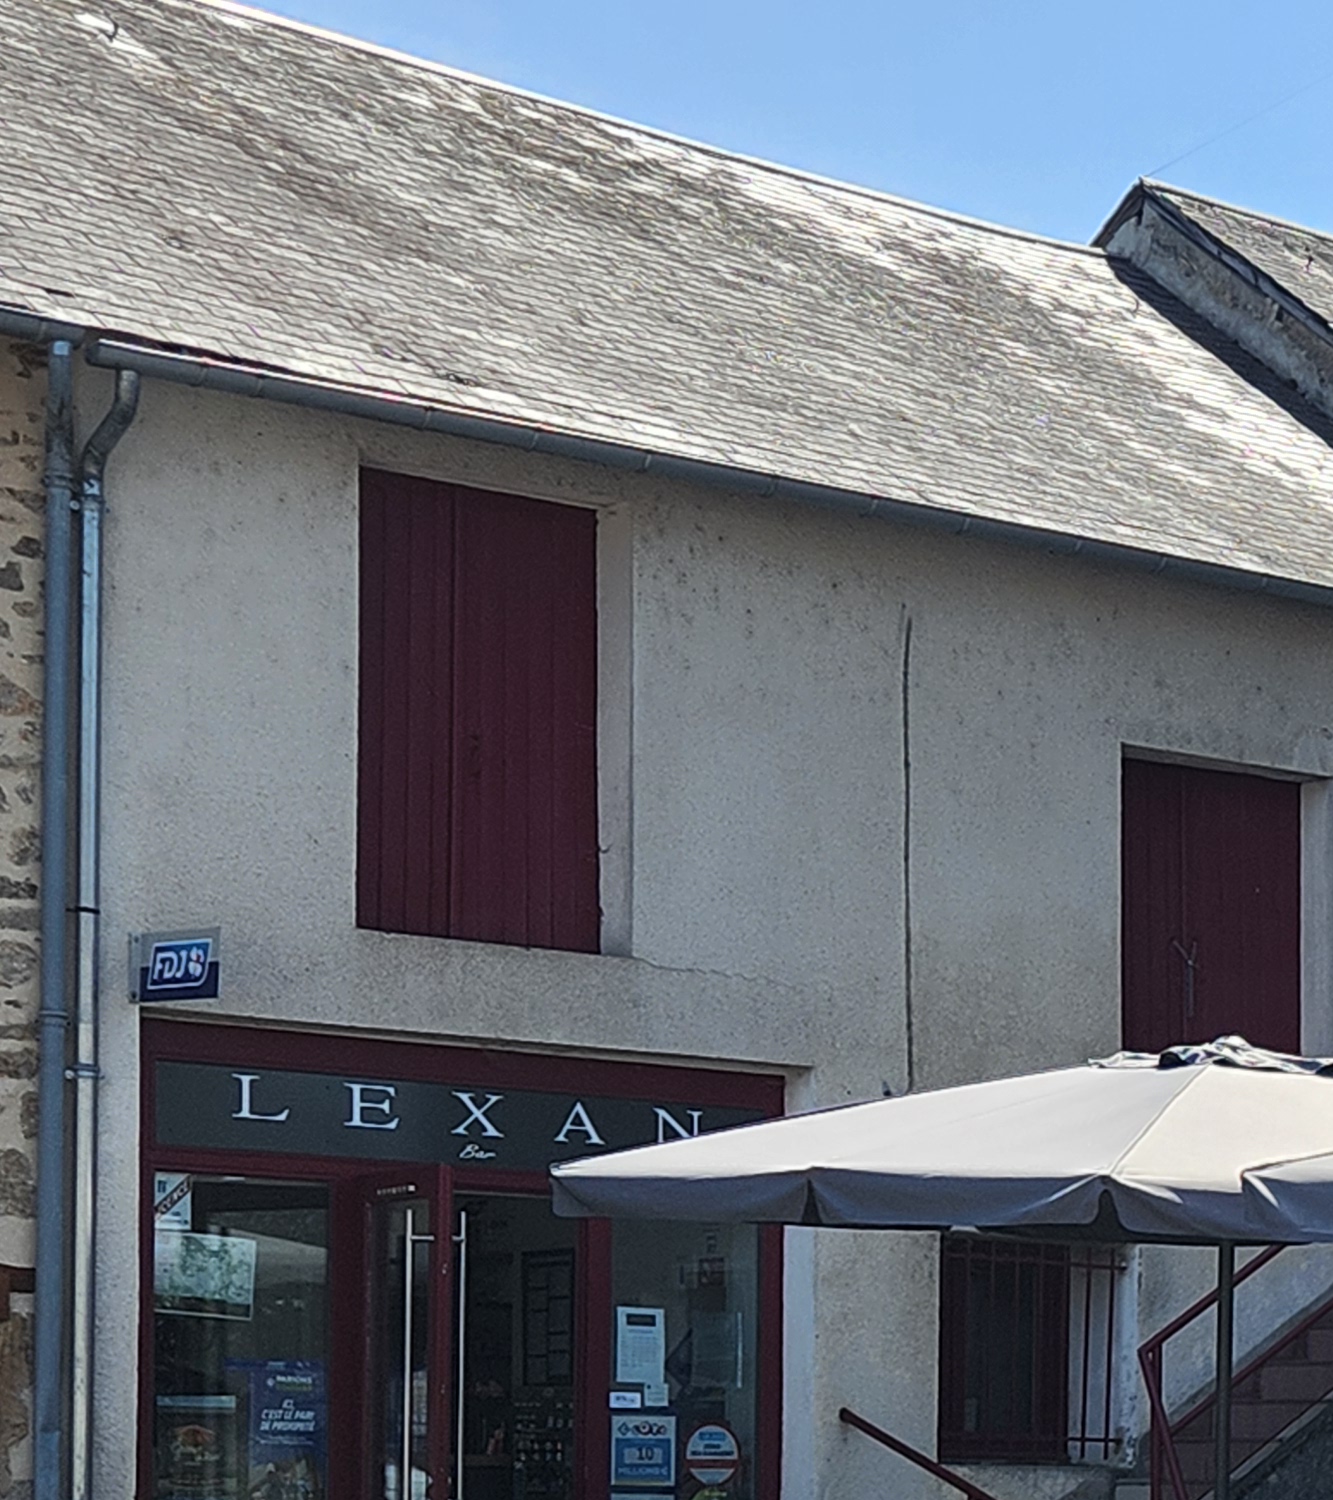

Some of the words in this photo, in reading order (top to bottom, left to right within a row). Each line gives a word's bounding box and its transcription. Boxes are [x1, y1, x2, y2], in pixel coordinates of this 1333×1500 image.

[152, 949, 189, 980] FDJ
[231, 1072, 704, 1146] LEXAN
[458, 1143, 497, 1160] Bar
[637, 1446, 655, 1461] 10
